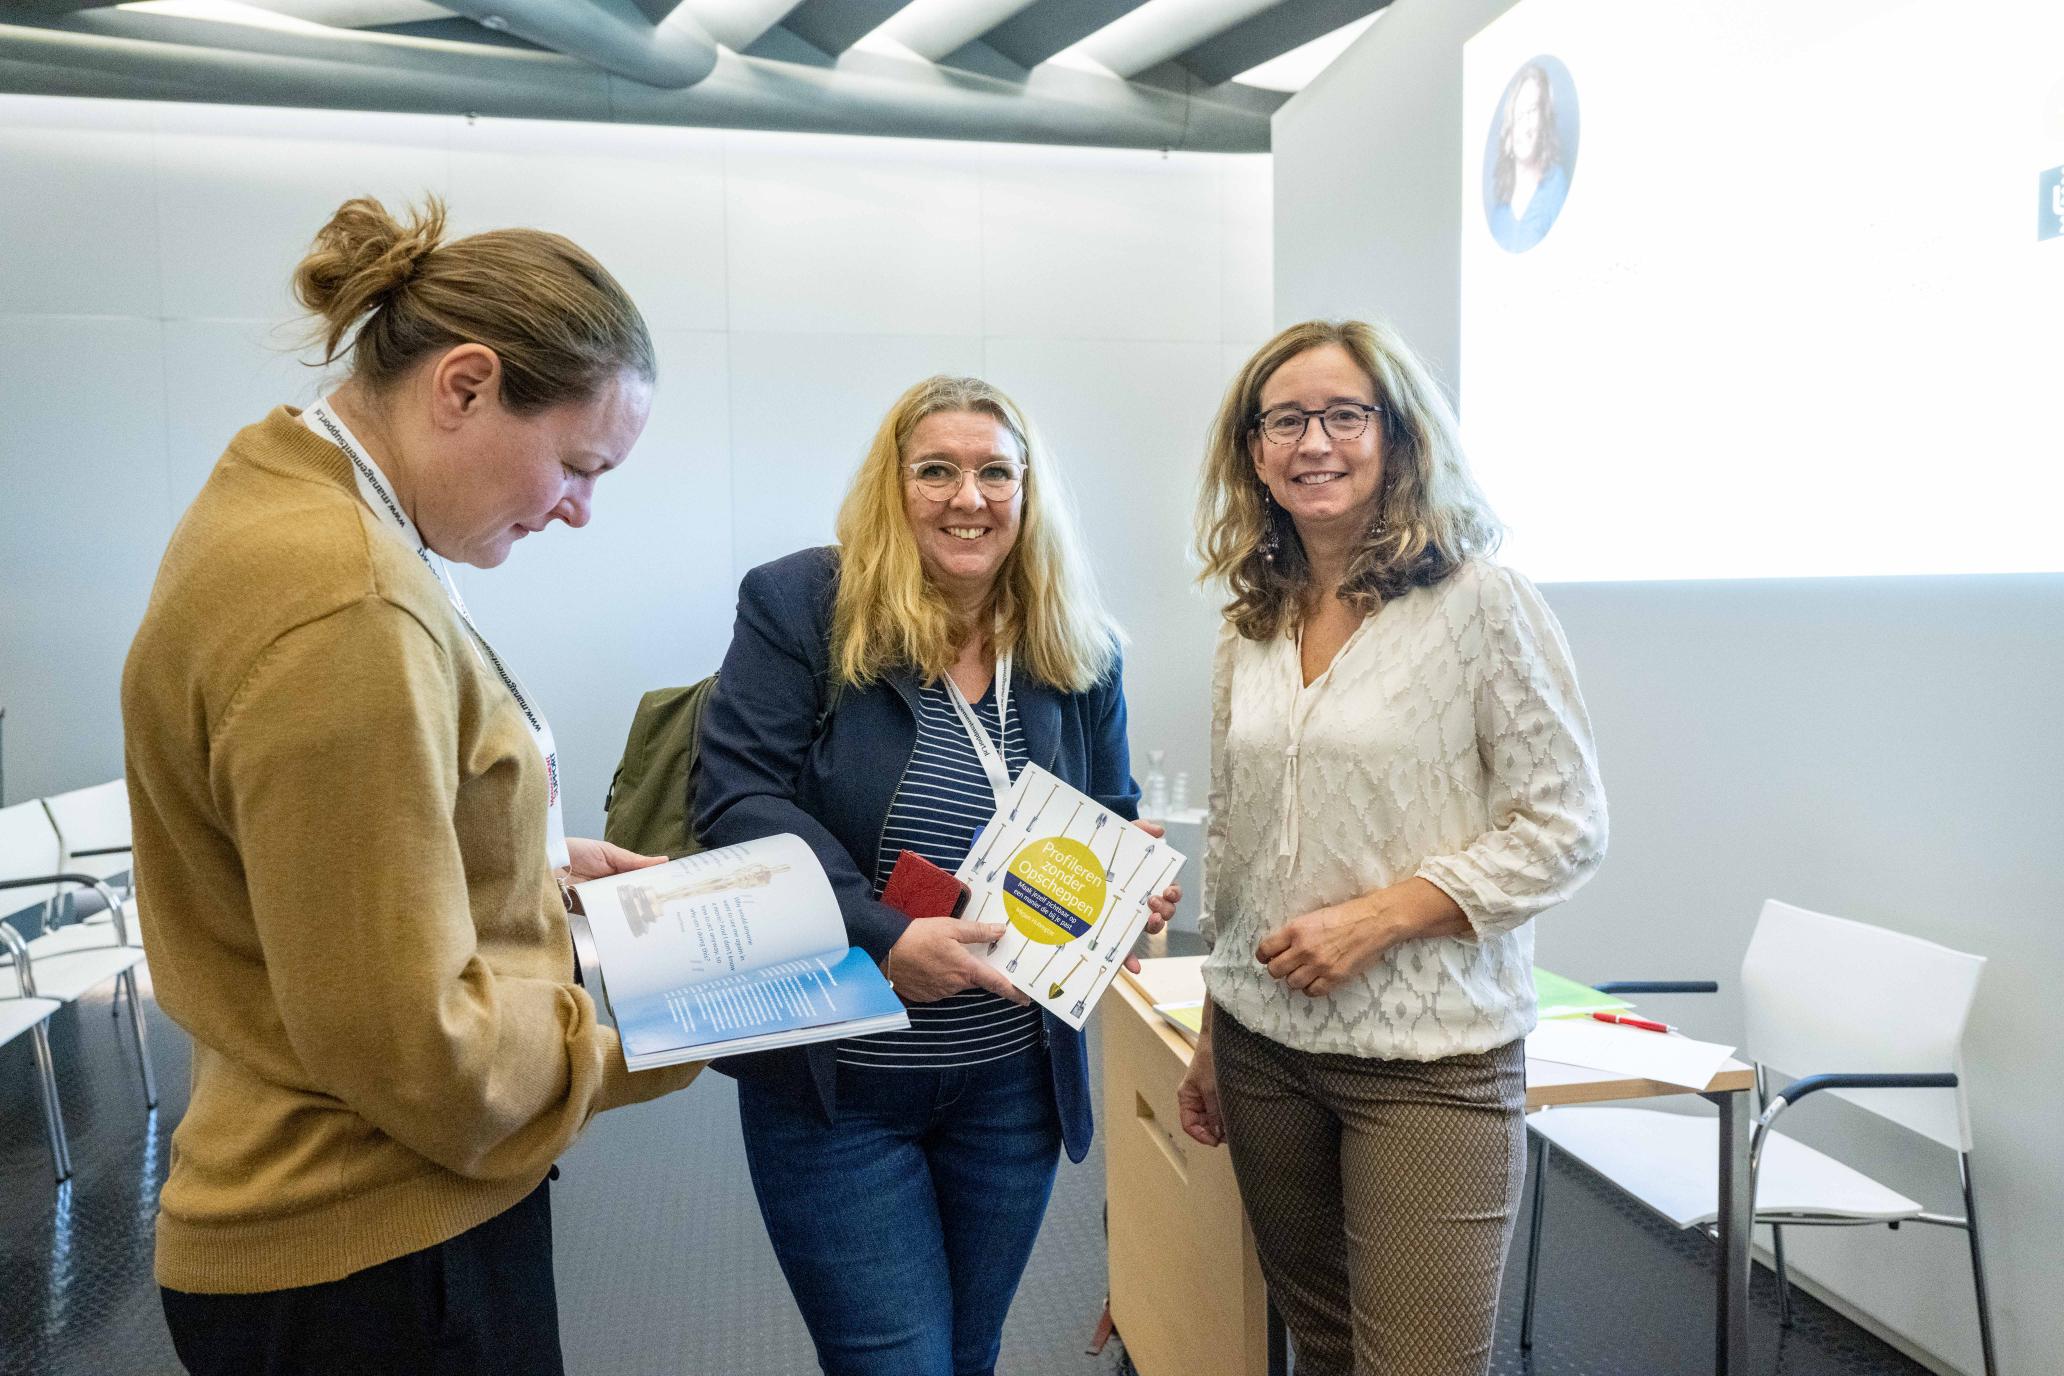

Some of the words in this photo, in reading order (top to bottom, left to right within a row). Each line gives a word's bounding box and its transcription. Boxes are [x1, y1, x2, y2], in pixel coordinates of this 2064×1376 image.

[1042, 841, 1102, 887] Profileren
[1042, 861, 1086, 892] zonder
[1017, 882, 1033, 895] Maak
[1031, 890, 1048, 905] jezelf
[1046, 900, 1070, 919] zichtbaar
[1069, 915, 1077, 924] op
[1019, 860, 1094, 917] Opscheppen
[1013, 889, 1024, 899] een
[1023, 895, 1041, 909] manier
[1040, 905, 1049, 914] die
[1048, 910, 1056, 921] bij
[1054, 915, 1061, 923] je
[1059, 918, 1073, 931] past
